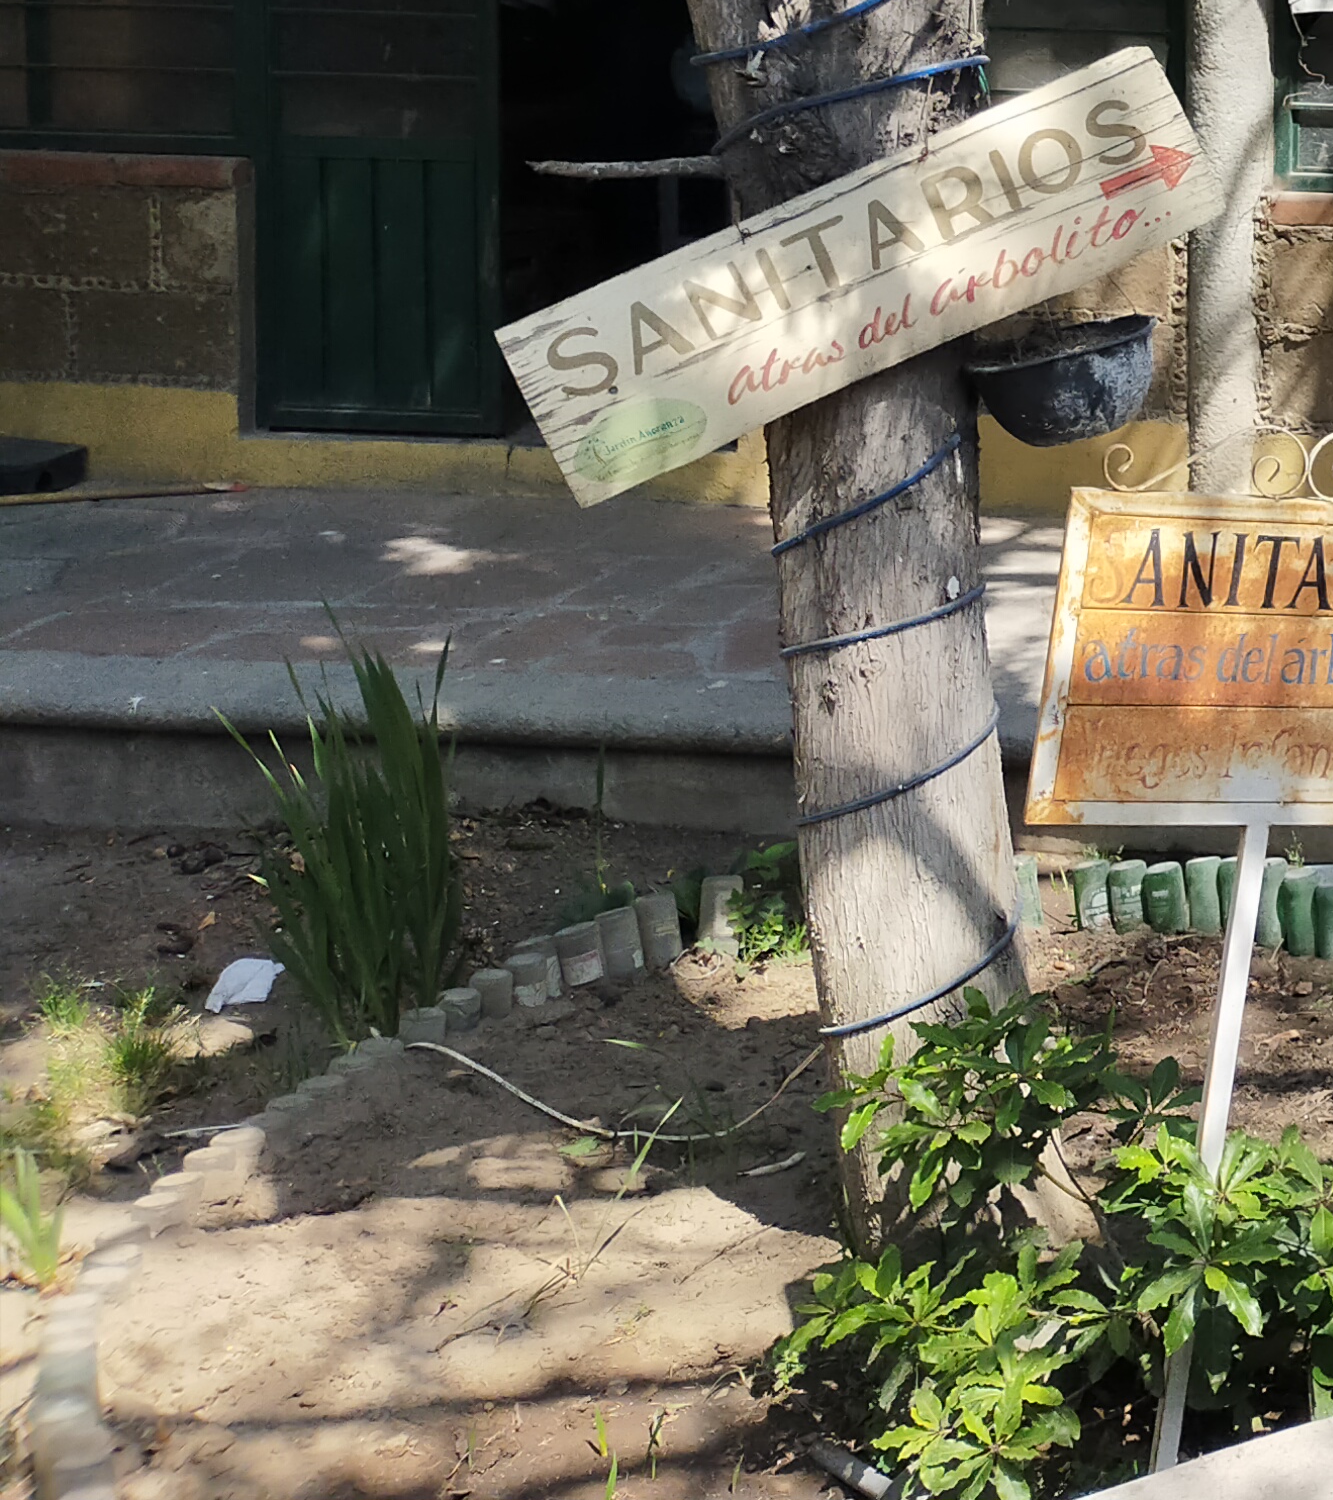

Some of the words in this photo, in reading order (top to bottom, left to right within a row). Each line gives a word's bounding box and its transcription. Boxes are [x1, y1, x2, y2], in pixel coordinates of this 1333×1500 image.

[546, 97, 1148, 399] SANITARIOS
[726, 336, 847, 406] atras
[857, 294, 918, 351] del
[1082, 628, 1205, 684] atras
[1215, 631, 1275, 685] del
